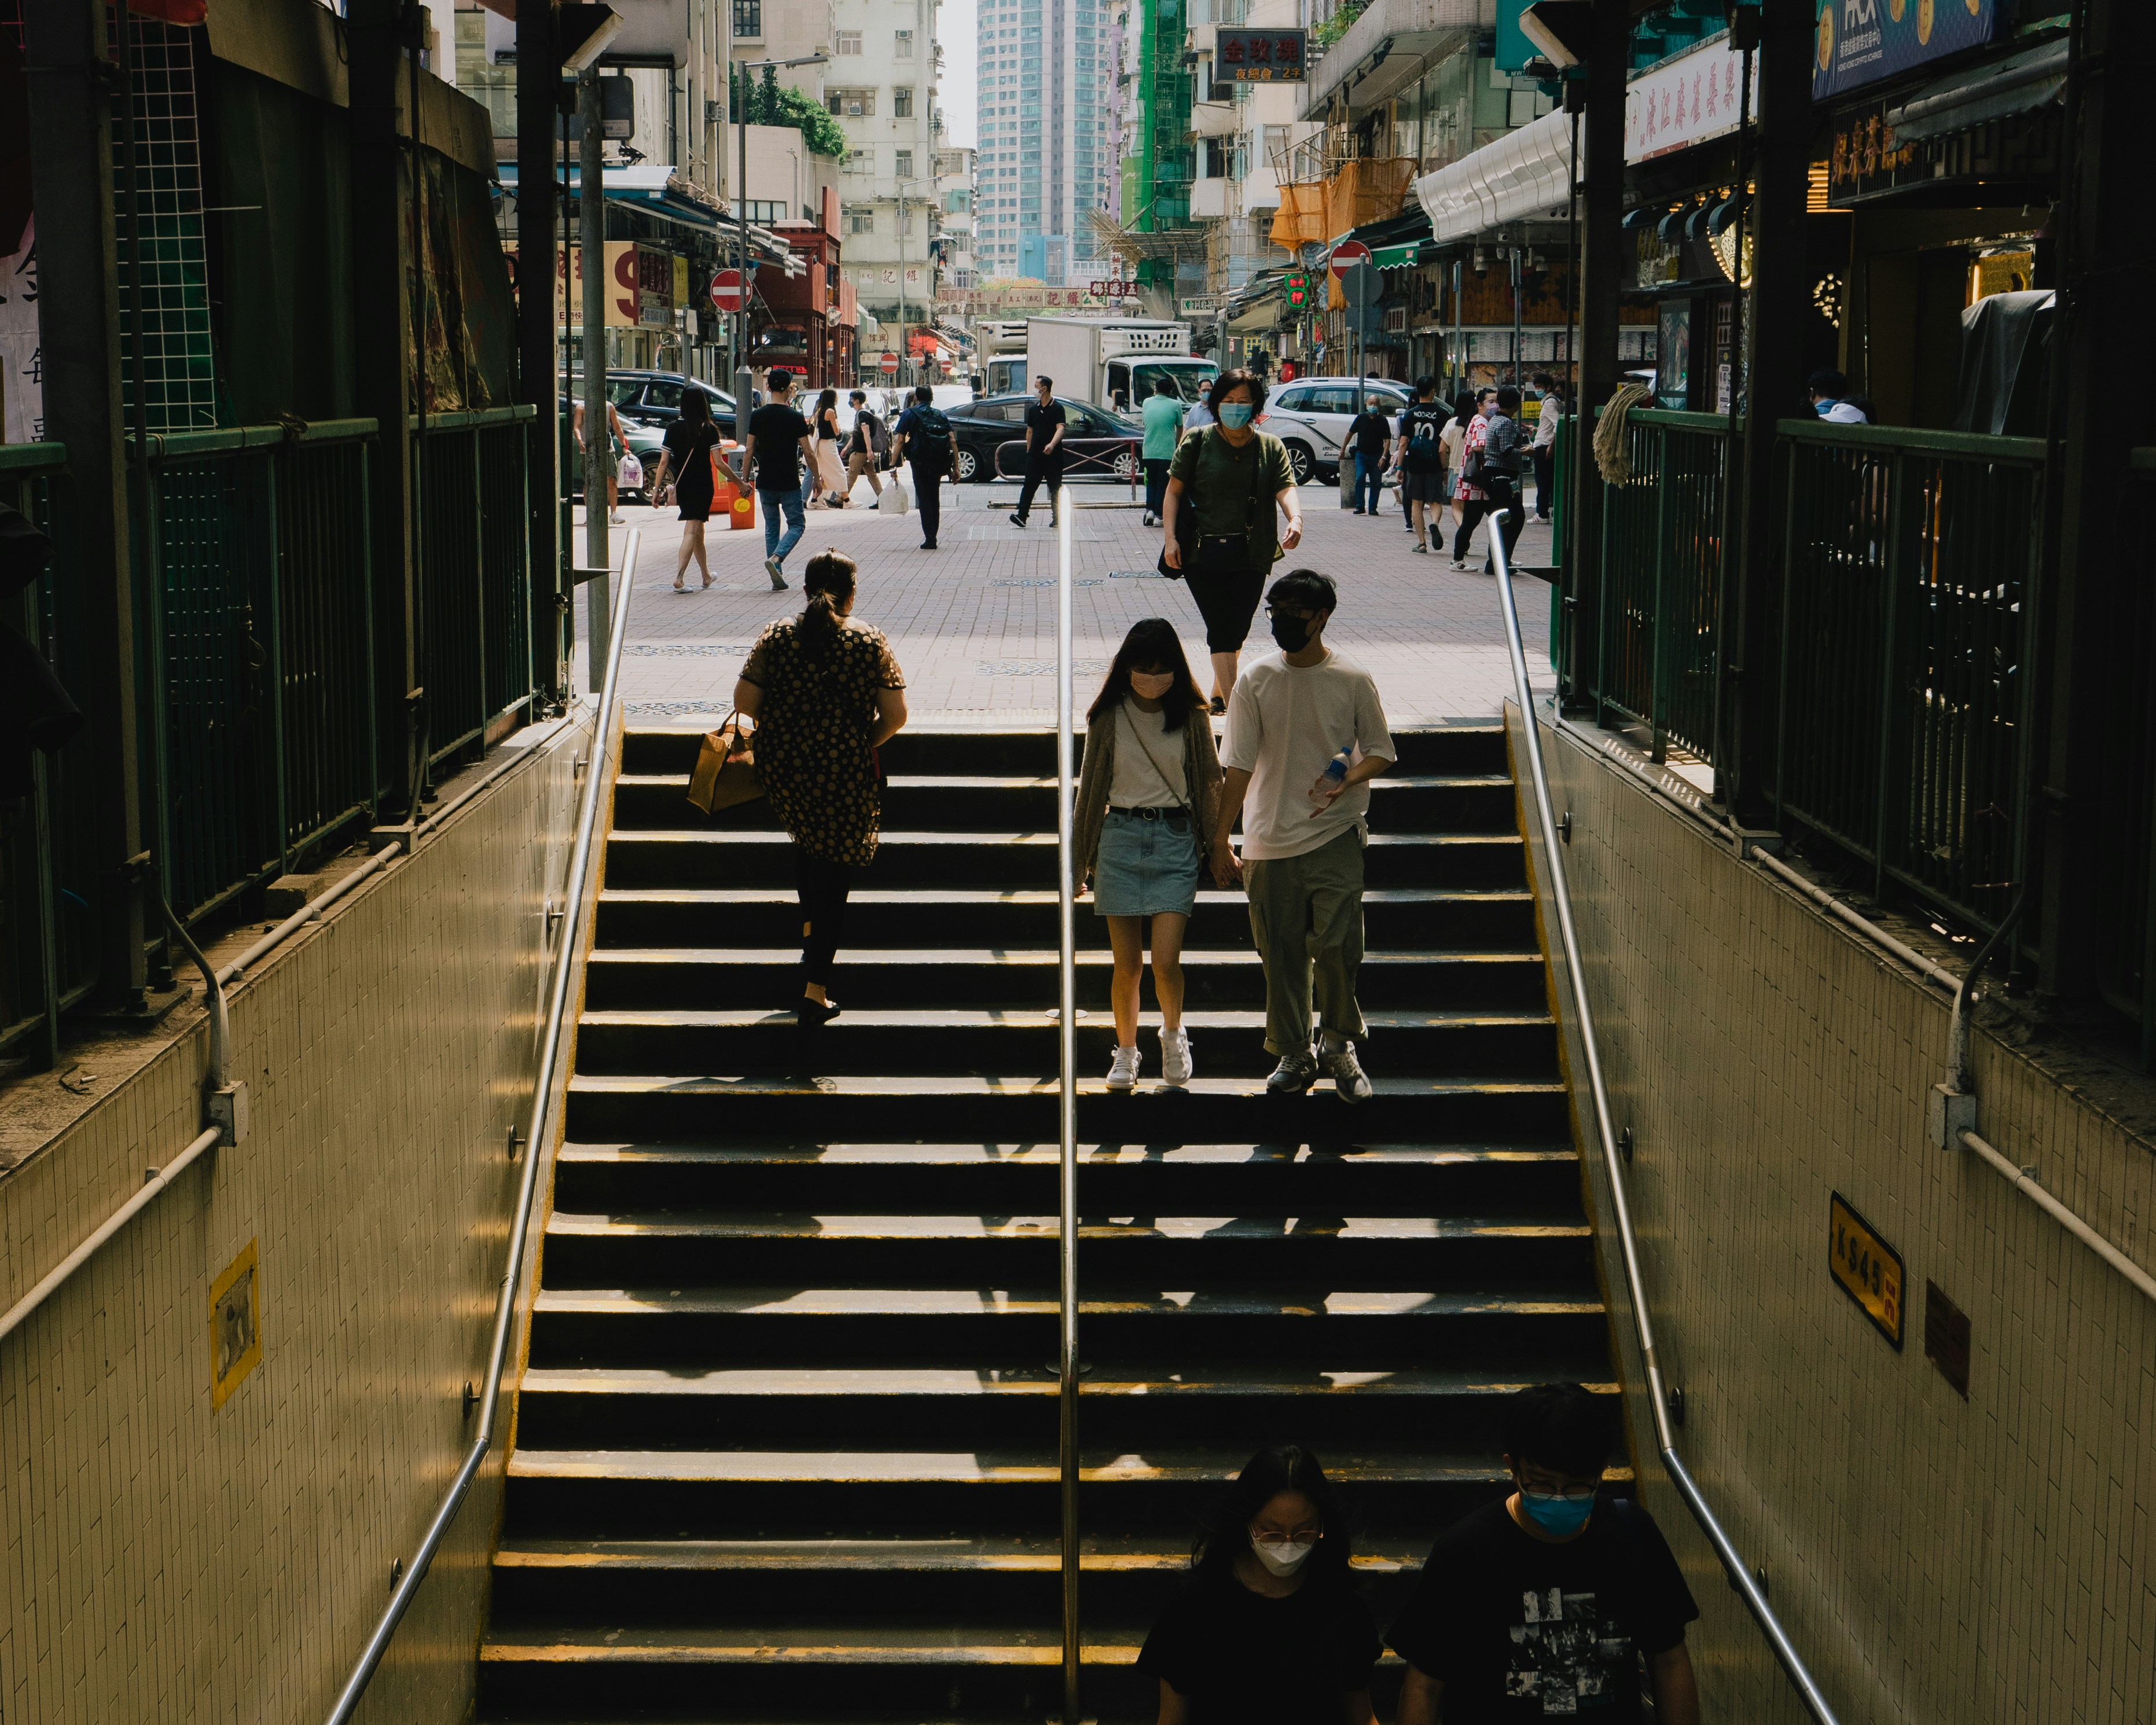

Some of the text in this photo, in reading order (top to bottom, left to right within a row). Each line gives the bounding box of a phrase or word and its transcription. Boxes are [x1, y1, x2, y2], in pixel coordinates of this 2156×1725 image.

[1223, 37, 1298, 62] 金玫瑰
[1236, 67, 1272, 80] 夜總會
[1838, 1223, 1880, 1297] KS45
